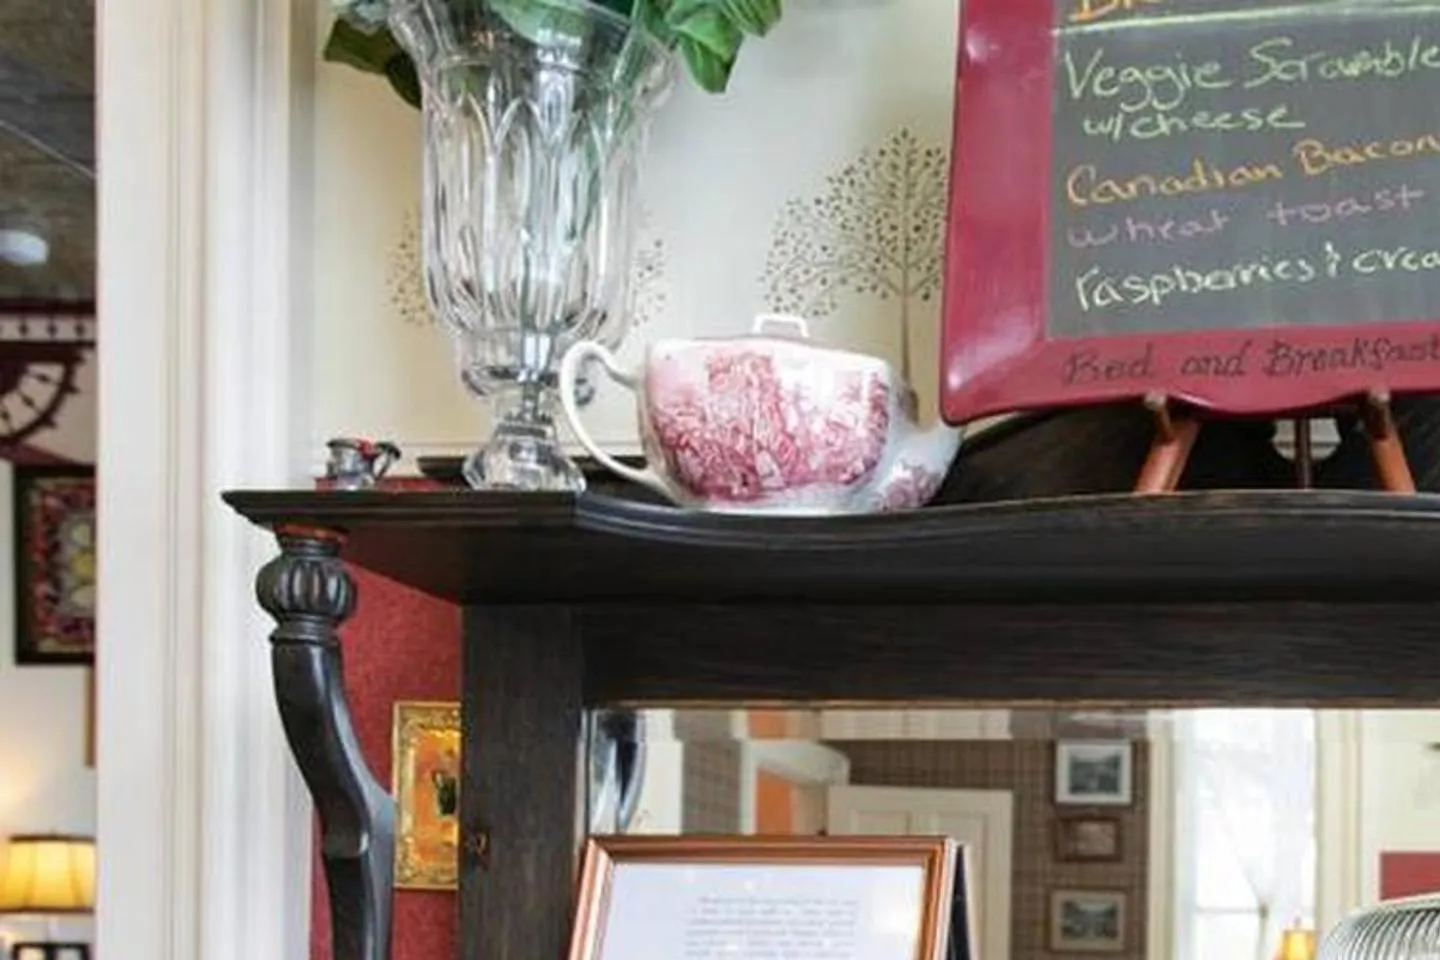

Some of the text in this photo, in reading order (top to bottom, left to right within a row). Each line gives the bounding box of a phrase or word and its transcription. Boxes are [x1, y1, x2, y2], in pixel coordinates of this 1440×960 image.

[1064, 48, 1232, 111] Veggie
[1083, 103, 1306, 141] w/cheese
[1066, 160, 1283, 207] Canadian
[1067, 183, 1424, 248] wheat toast
[1065, 344, 1155, 385] Bed
[1181, 340, 1251, 378] and
